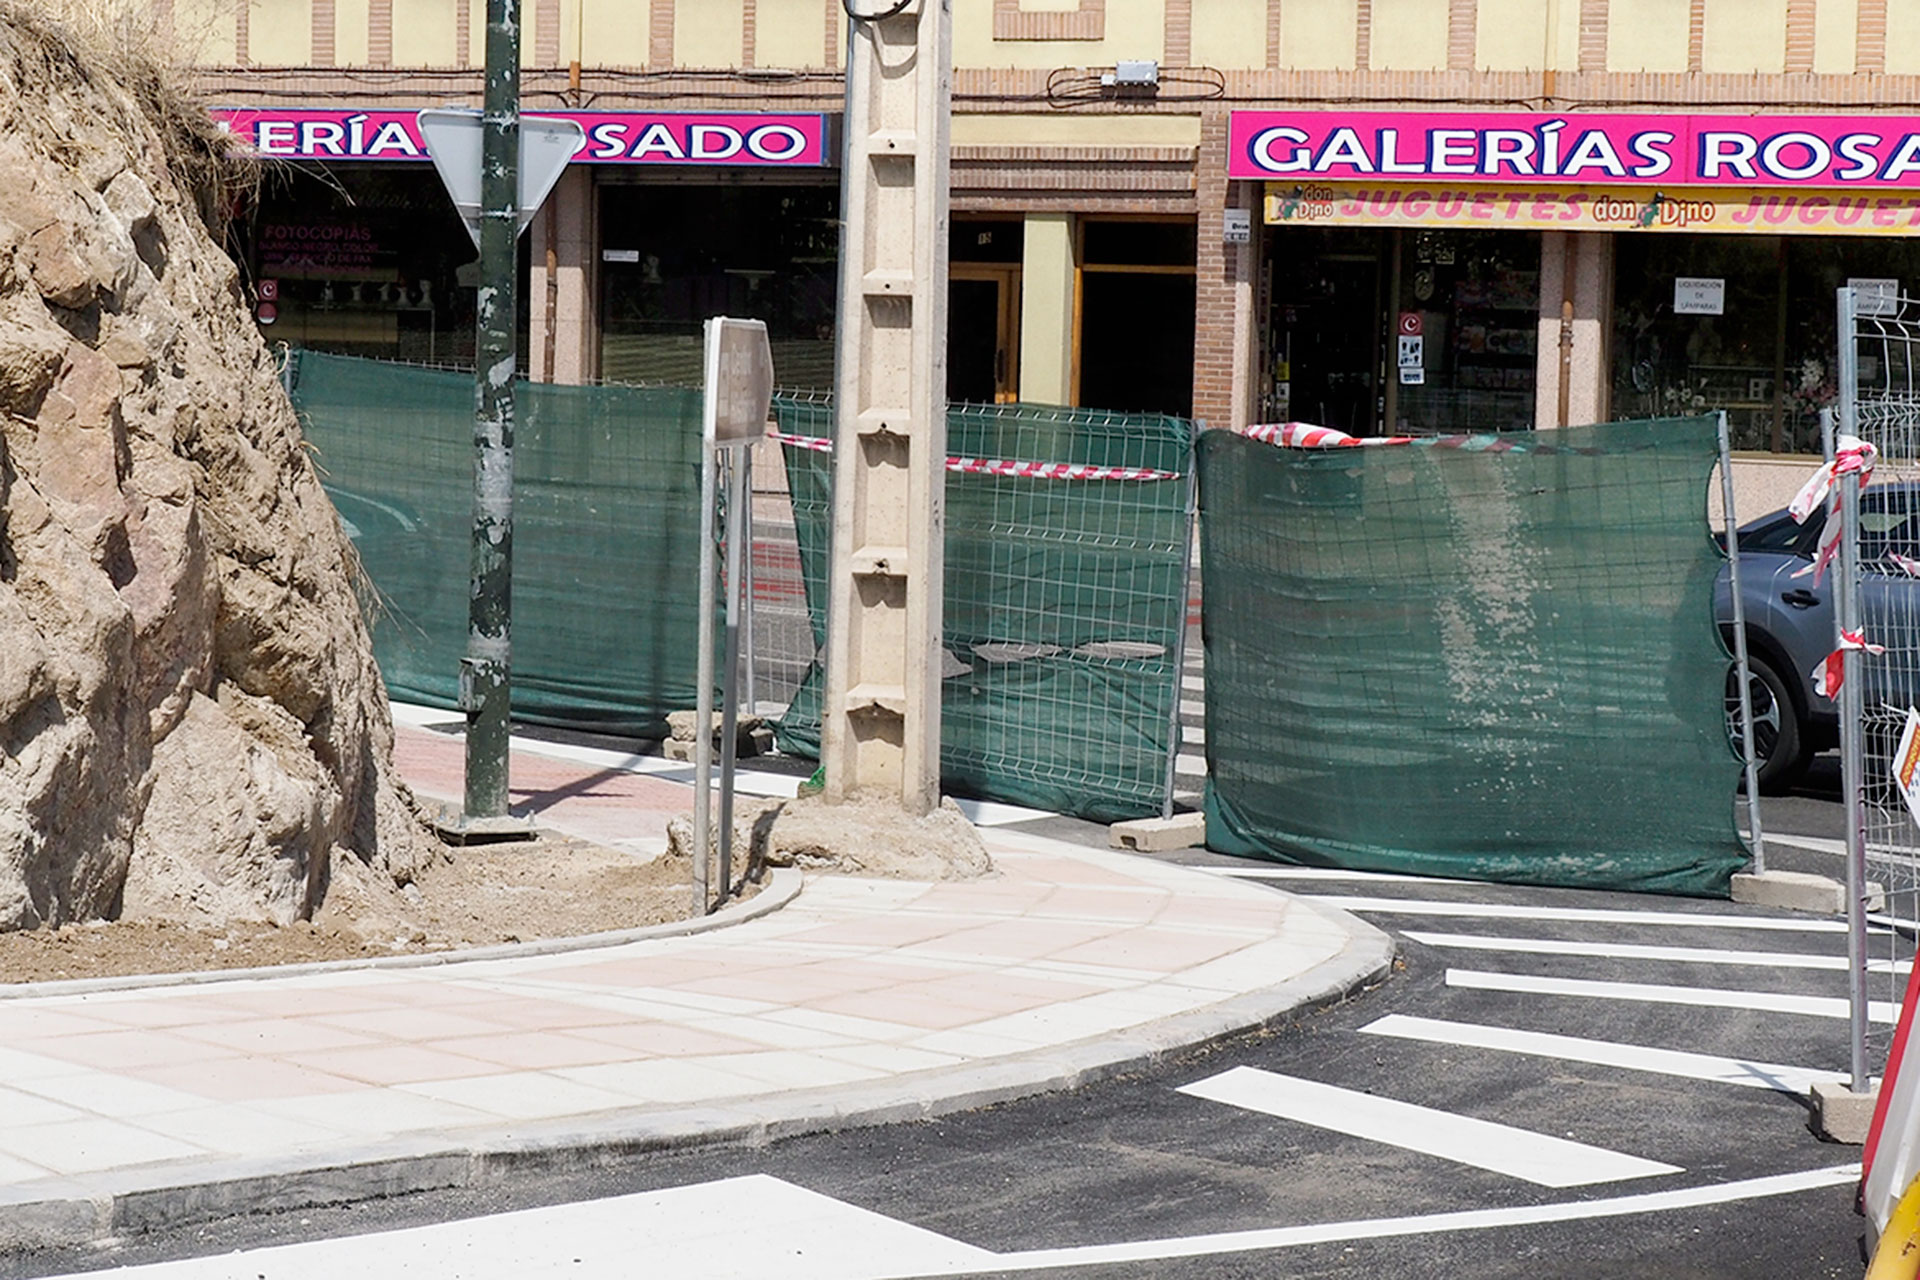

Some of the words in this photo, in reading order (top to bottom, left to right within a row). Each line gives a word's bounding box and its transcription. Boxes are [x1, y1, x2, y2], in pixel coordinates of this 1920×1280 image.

[217, 114, 431, 157] ERÍA
[571, 124, 807, 160] SADO
[1247, 119, 1675, 177] GALERÍAS
[1697, 131, 1920, 180] ROSA
[1297, 201, 1334, 219] Dino
[1304, 185, 1333, 200] don
[1340, 190, 1589, 221] JUGUETES
[1593, 195, 1637, 222] don
[1660, 196, 1716, 227] Dino
